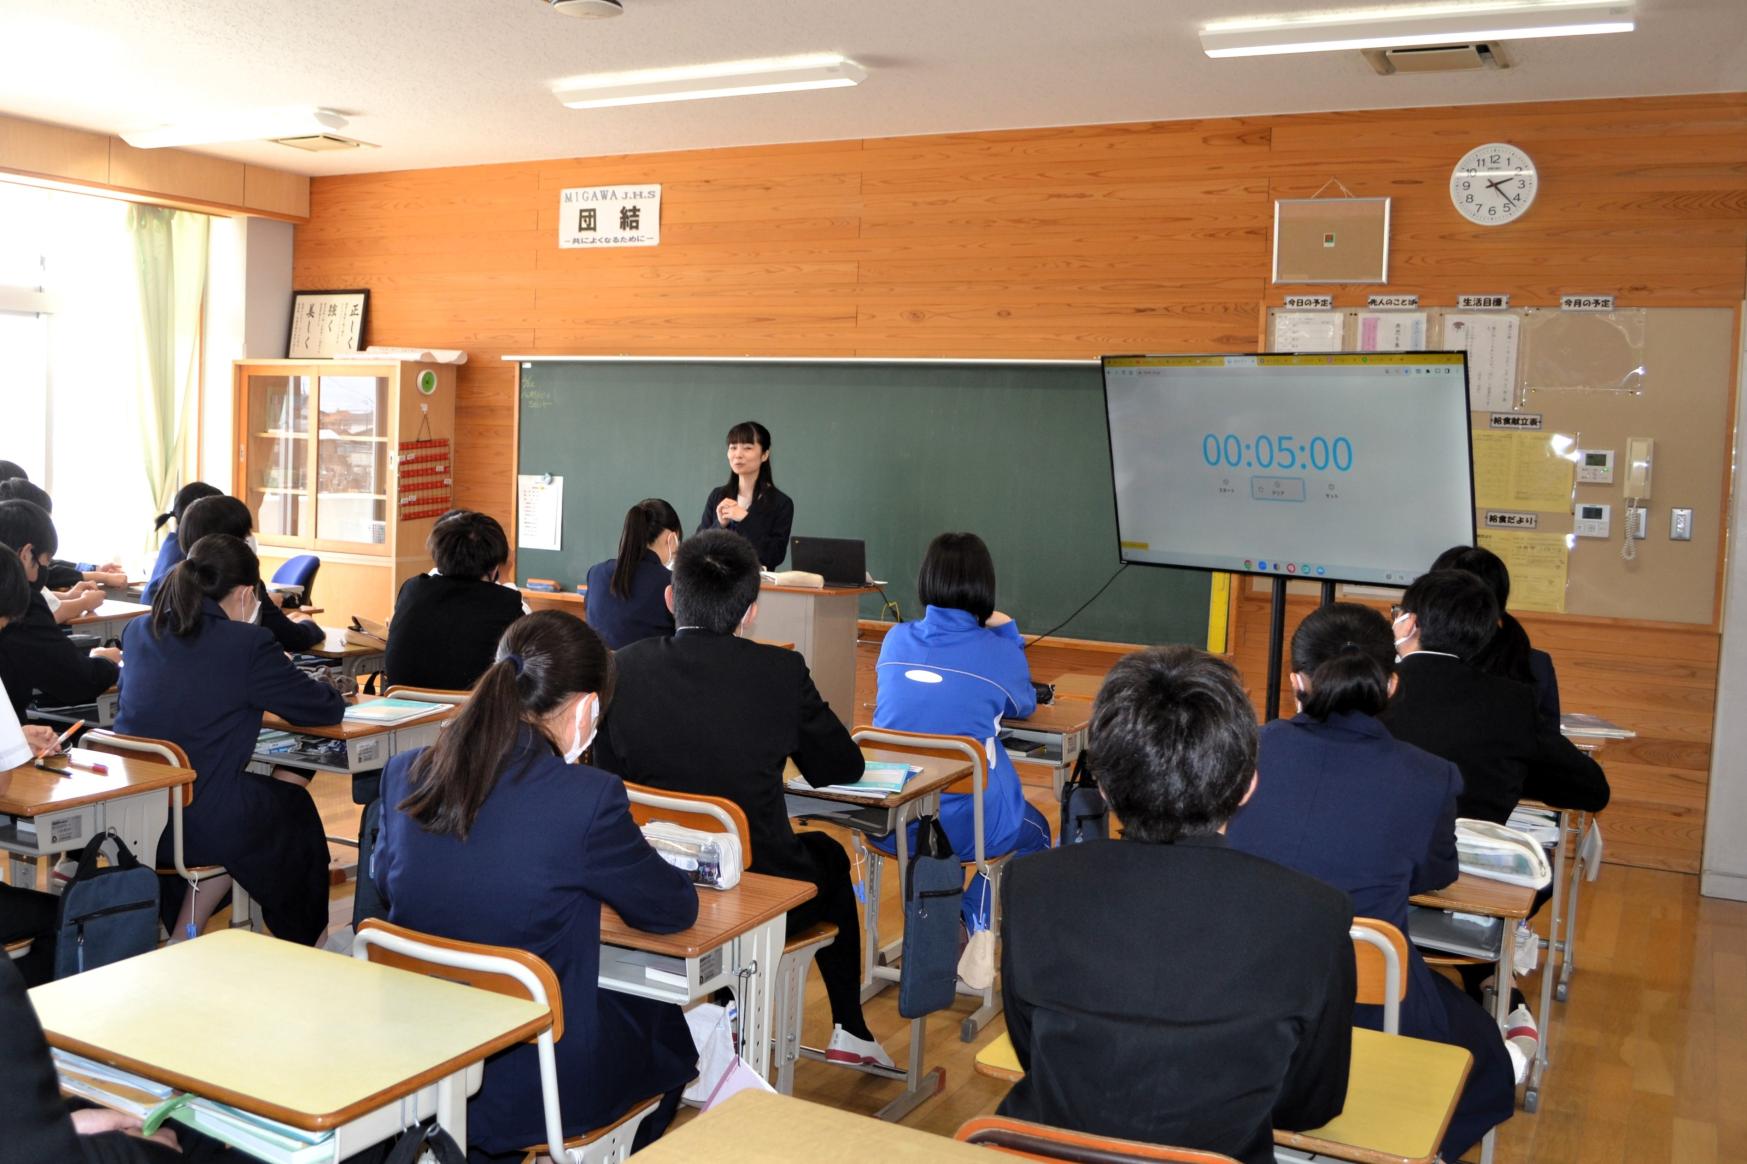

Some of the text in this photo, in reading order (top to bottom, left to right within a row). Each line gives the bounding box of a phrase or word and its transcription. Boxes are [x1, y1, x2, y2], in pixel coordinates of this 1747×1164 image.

[1476, 158, 1486, 167] 11
[1489, 154, 1501, 164] 12
[1506, 157, 1511, 167] 1
[1466, 168, 1477, 178] 10
[1462, 181, 1471, 191] 9
[1517, 179, 1526, 189] 3
[564, 190, 618, 203] MIGAWA
[1465, 194, 1474, 203] 8
[1513, 193, 1521, 202] 4
[1475, 204, 1483, 213] 7
[1488, 206, 1497, 216] 6
[1503, 203, 1511, 213] 5
[1287, 298, 1330, 307] 今日の予定
[1462, 297, 1503, 307] 生活目標
[1564, 298, 1611, 308] 今月の予定
[304, 303, 316, 350] 美しく
[347, 303, 361, 350] 正しく
[1202, 433, 1353, 472] 00:05:00
